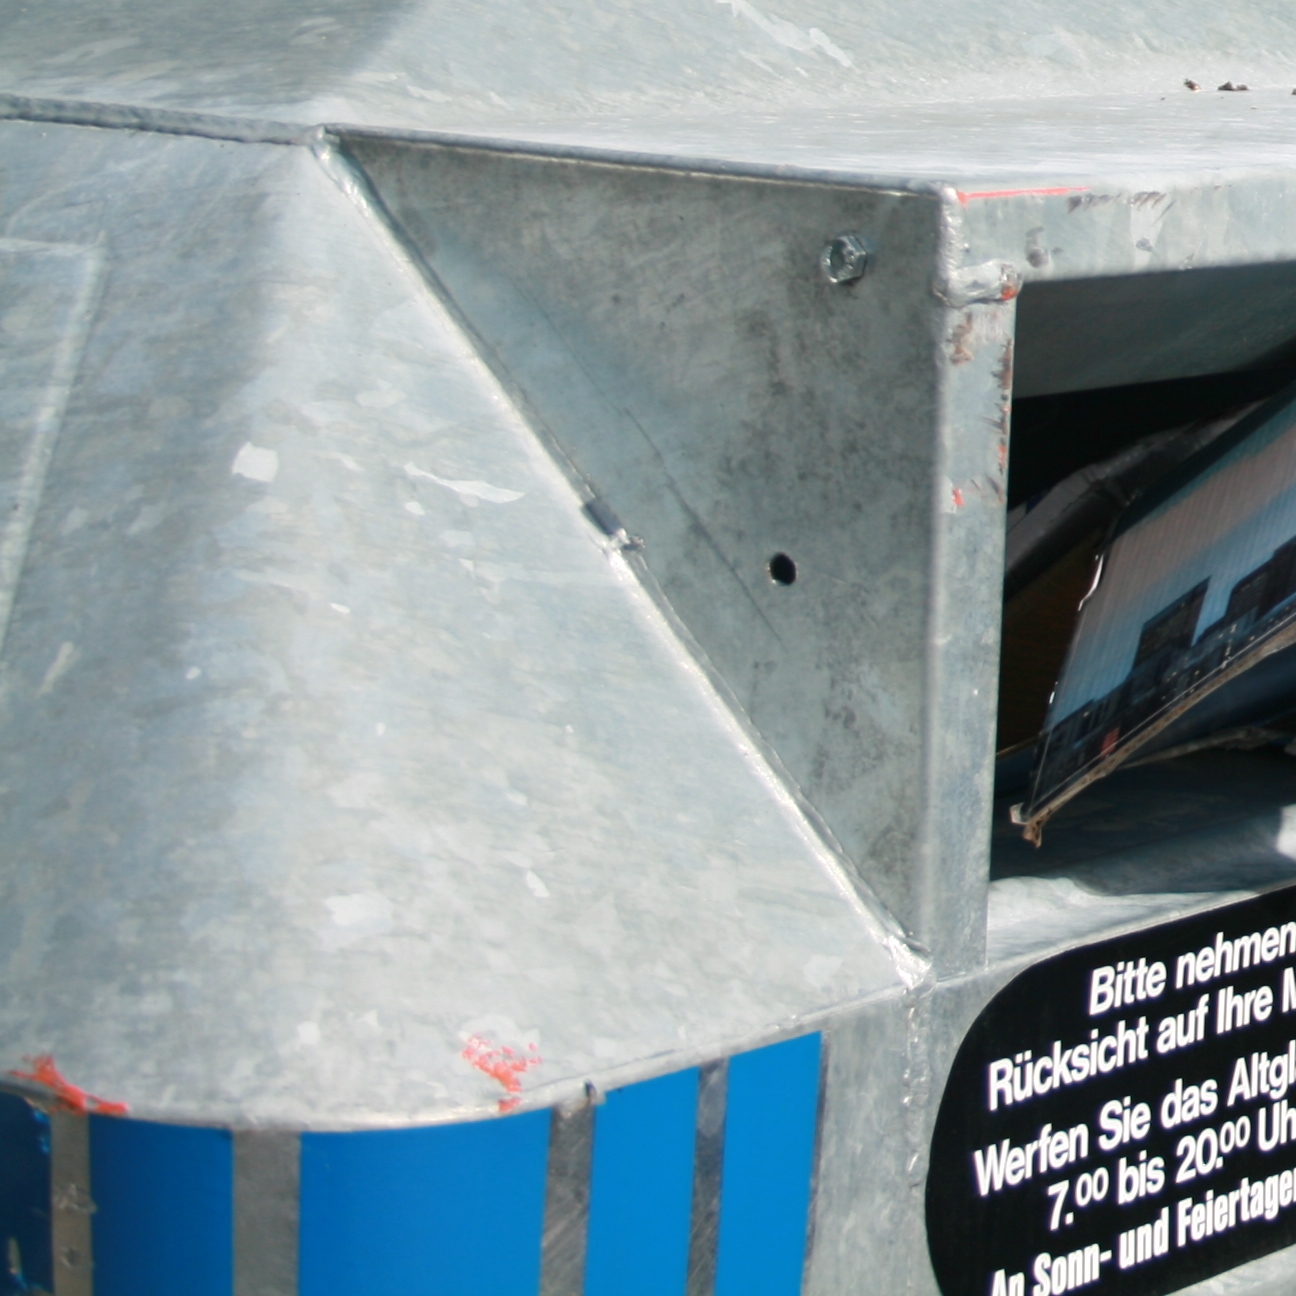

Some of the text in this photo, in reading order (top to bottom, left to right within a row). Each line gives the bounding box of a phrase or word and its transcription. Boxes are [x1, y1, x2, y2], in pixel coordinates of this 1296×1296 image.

[1089, 960, 1167, 1016] Bitte
[988, 1021, 1149, 1112] Rücksicht
[1156, 992, 1210, 1054] auf
[1216, 983, 1273, 1036] Ihre
[975, 1122, 1089, 1197] Werfen
[1099, 1097, 1152, 1151] Sie
[1160, 1078, 1218, 1124] das
[1117, 1151, 1166, 1206] bis
[1032, 1242, 1112, 1296] Sonn-
[1119, 1207, 1169, 1269] und
